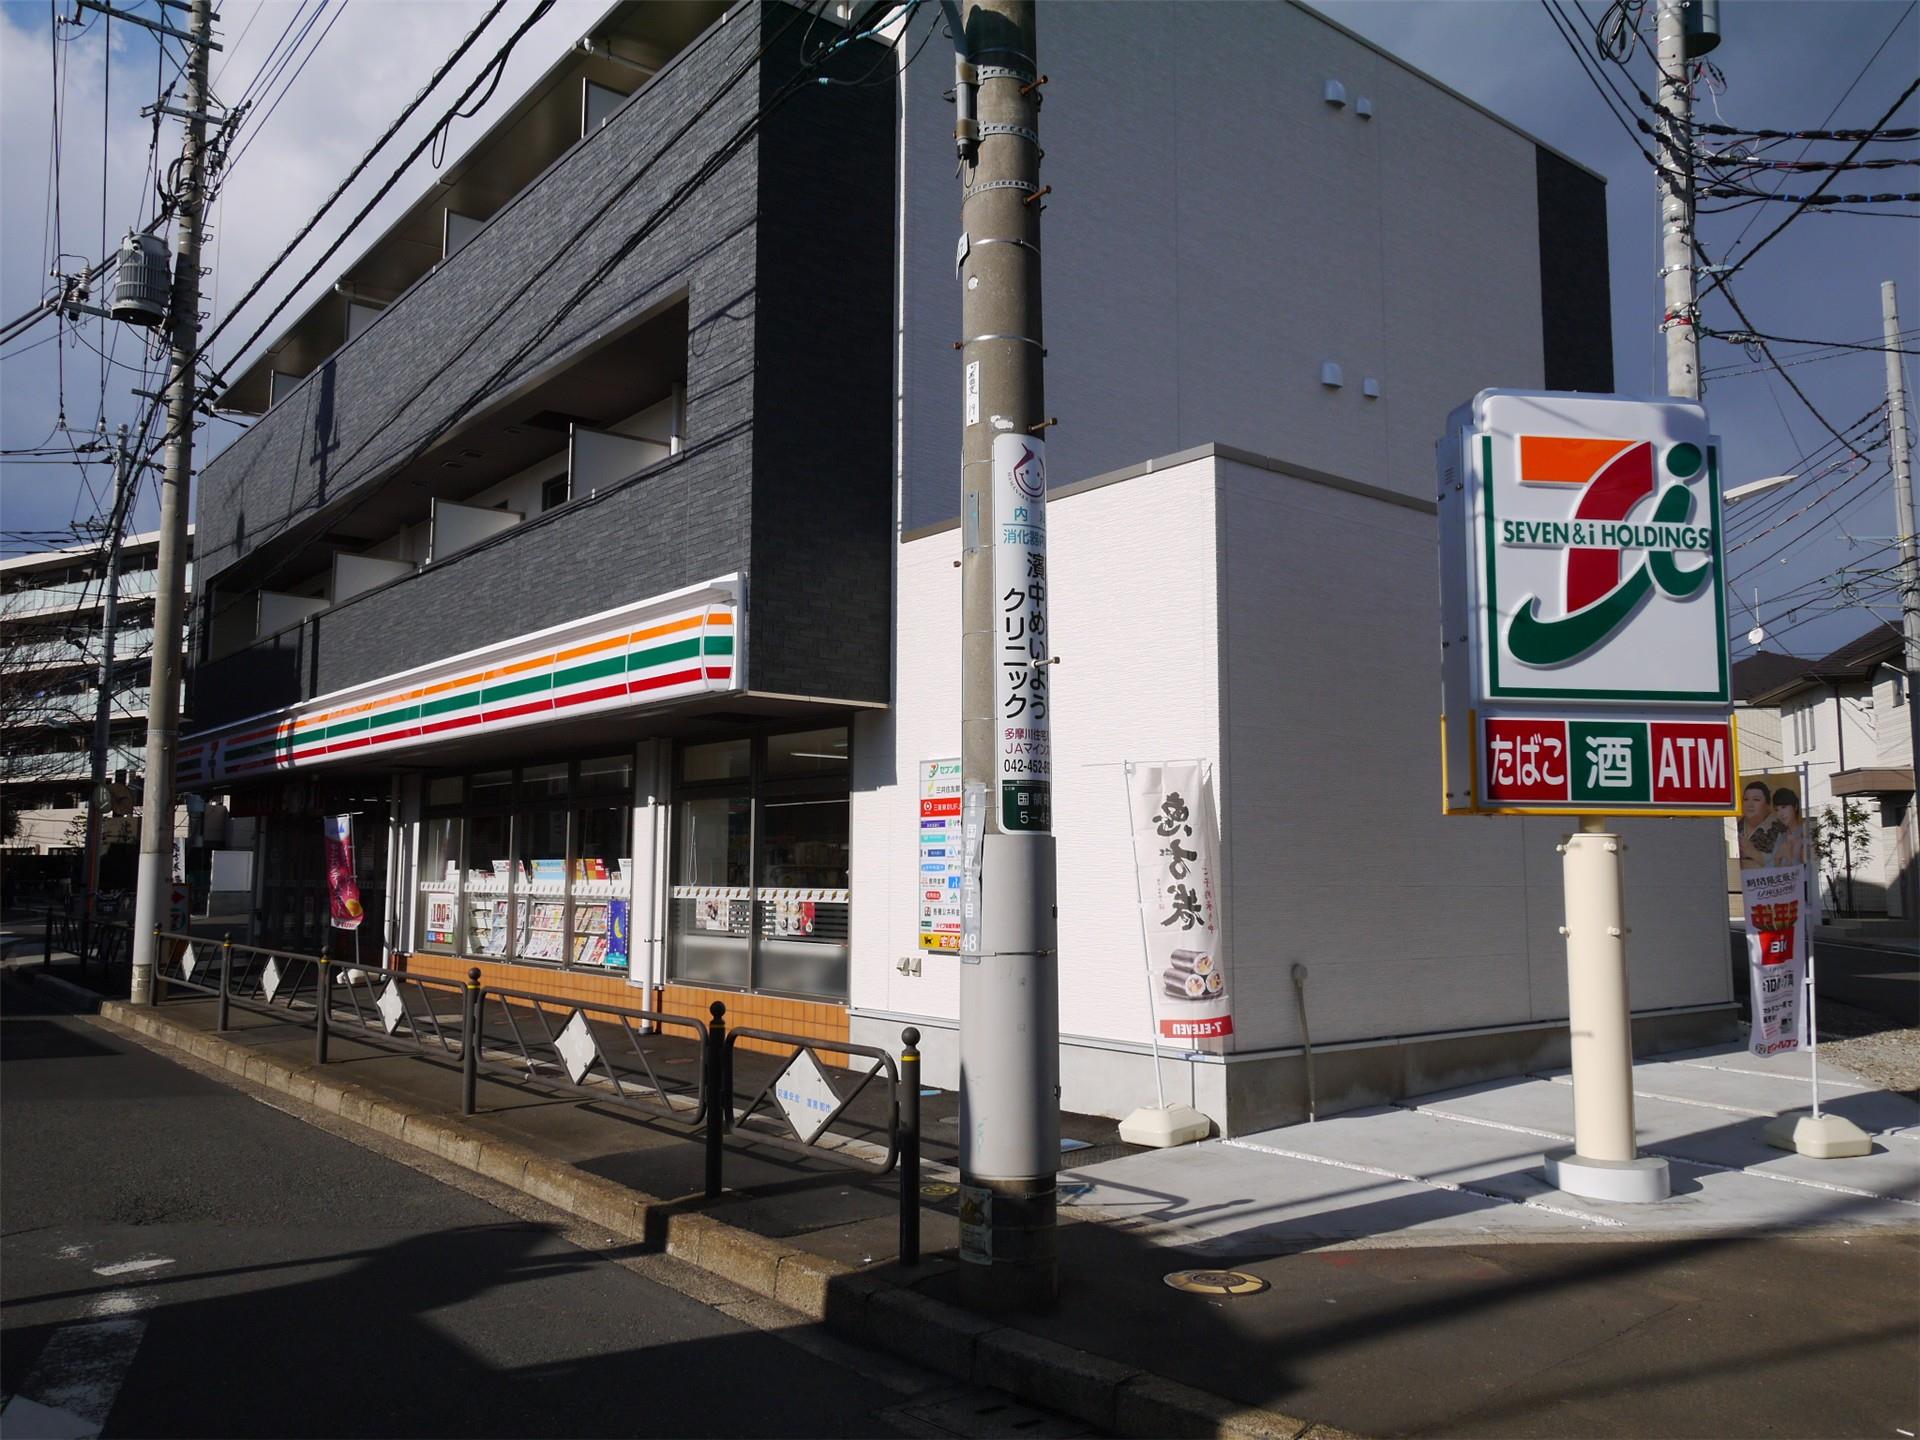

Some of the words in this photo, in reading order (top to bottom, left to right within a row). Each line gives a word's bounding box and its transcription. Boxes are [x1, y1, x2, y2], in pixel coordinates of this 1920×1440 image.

[1503, 519, 1596, 546] SEVEN&i
[1601, 523, 1711, 550] HOLDINGS
[1003, 587, 1028, 719] クリニック
[1490, 733, 1565, 787] たばこ
[1585, 735, 1634, 789] 酒
[1657, 737, 1726, 789] ATM
[961, 933, 977, 952] 48
